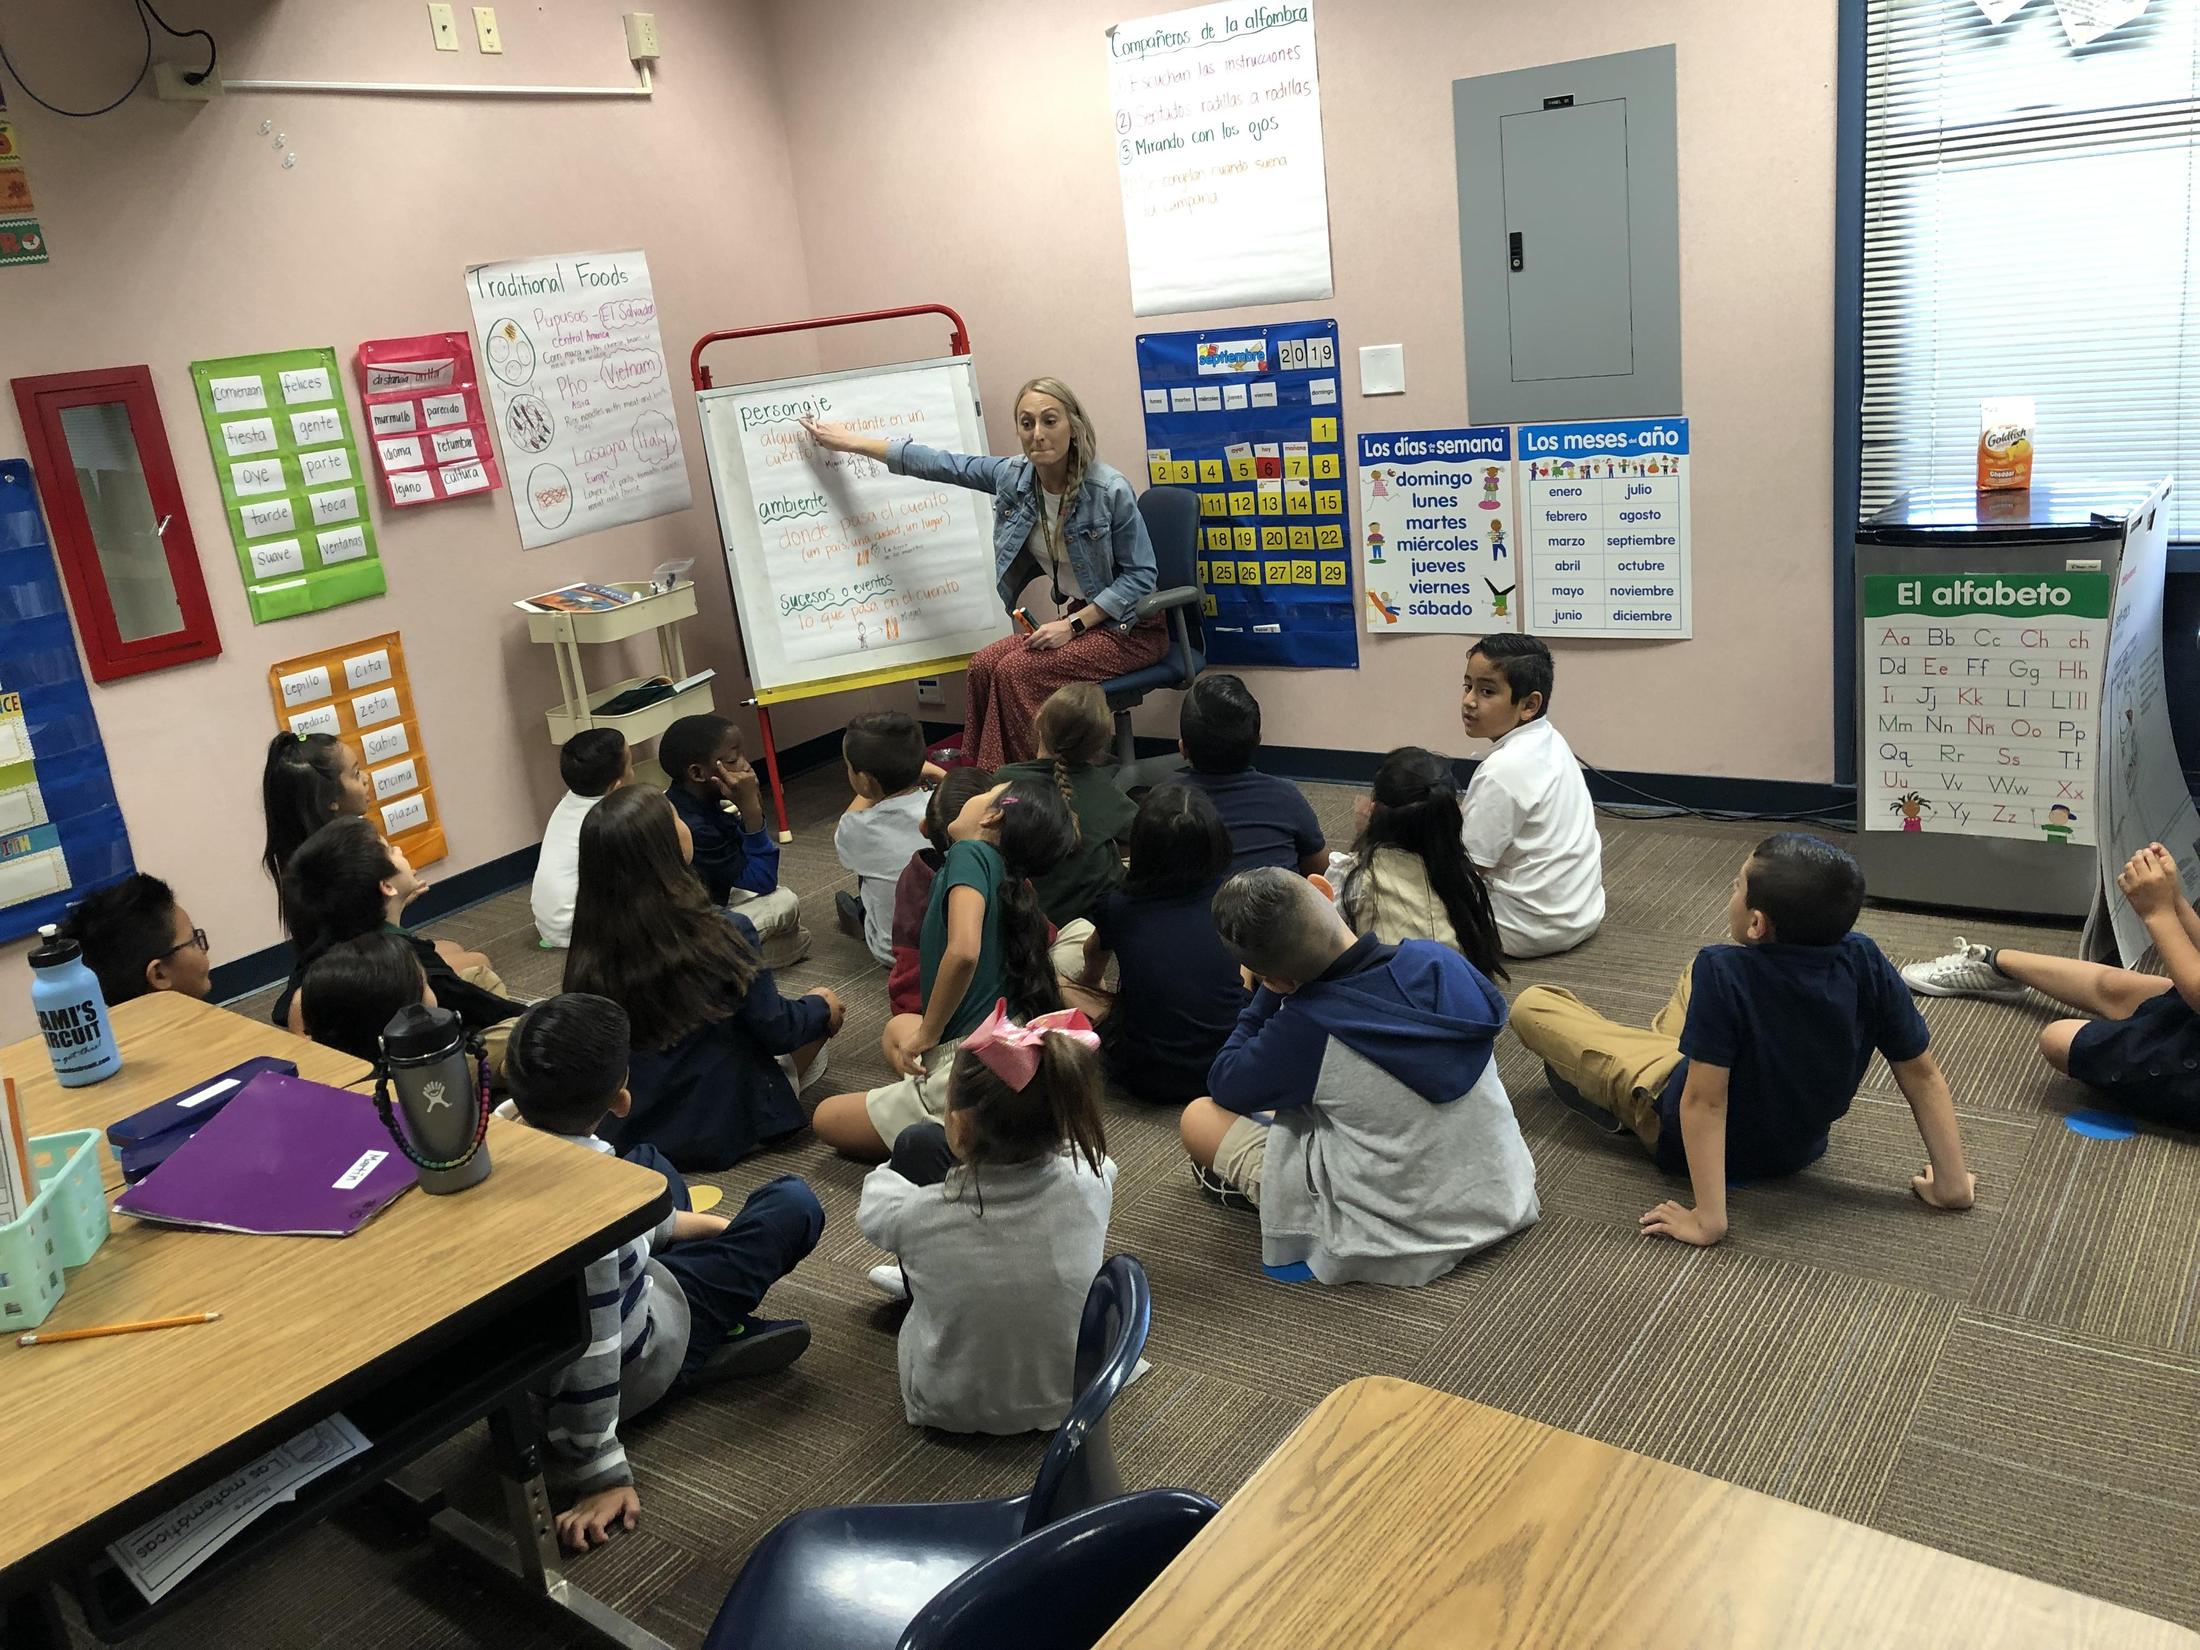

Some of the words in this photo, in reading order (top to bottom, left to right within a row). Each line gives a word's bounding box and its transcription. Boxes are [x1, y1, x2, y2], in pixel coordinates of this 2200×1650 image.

[1111, 30, 1191, 61] Compañeros
[1201, 23, 1215, 40] de
[1225, 16, 1238, 33] la
[1245, 7, 1308, 29] alfombra
[1198, 62, 1215, 77] las
[1224, 45, 1301, 72] instrucciones
[1250, 92, 1260, 104] a
[1265, 79, 1312, 102] rodillas
[1135, 135, 1185, 156] Mirando
[1192, 128, 1214, 144] con
[1222, 122, 1239, 139] los
[1248, 116, 1279, 142] ojos
[468, 263, 565, 299] Traditional
[576, 262, 630, 287] Foods
[533, 307, 589, 337] Pupusas
[600, 305, 614, 322] El
[1199, 348, 1265, 368] septiembre
[284, 375, 322, 394] felices
[556, 374, 588, 400] Pho
[605, 359, 656, 384] Vietnam
[427, 404, 460, 421] parecido
[571, 399, 591, 410] Asia
[740, 395, 832, 431] personaje
[890, 413, 902, 426] en
[909, 409, 925, 422] un
[227, 426, 268, 443] fiesta
[299, 416, 334, 440] gente
[1988, 428, 2027, 447] Goldfish
[437, 437, 473, 452] retumbar
[1364, 438, 1391, 458] Los
[1394, 436, 1427, 456] días
[1436, 436, 1503, 455] semana
[1527, 431, 1559, 453] Los
[1564, 432, 1627, 450] meses
[1638, 426, 1679, 447] año
[572, 439, 628, 471] Lasagna
[636, 429, 669, 458] Italy
[765, 447, 813, 467] cuento
[306, 454, 342, 479] parte
[394, 480, 422, 495] lejano
[1396, 470, 1473, 490] domingo
[1412, 492, 1458, 508] lunes
[1549, 487, 1583, 498] enero
[1625, 483, 1653, 500] julio
[319, 499, 347, 514] toca
[759, 491, 828, 518] ambiente
[1208, 500, 1222, 512] 11
[1234, 497, 1251, 511] 12
[1262, 497, 1278, 511] 13
[1290, 496, 1308, 510] 14
[1320, 495, 1337, 510] 15
[251, 506, 289, 525] tarde
[778, 521, 829, 550] donde
[840, 510, 878, 540] pasa
[881, 501, 895, 521] el
[900, 491, 949, 516] cuento
[1406, 515, 1467, 530] martes
[1546, 510, 1588, 522] febrero
[1619, 509, 1662, 523] agosto
[322, 535, 363, 556] ventanas
[1212, 532, 1228, 546] 18
[1238, 532, 1252, 546] 19
[1266, 531, 1283, 545] 20
[1294, 531, 1309, 545] 21
[1320, 530, 1339, 544] 22
[1397, 536, 1479, 552] miércoles
[1548, 536, 1586, 547] marzo
[1607, 535, 1676, 550] septiembre
[1216, 566, 1232, 580] 25
[1241, 567, 1257, 580] 26
[1269, 566, 1286, 580] 27
[1295, 565, 1312, 579] 28
[1325, 566, 1342, 580] 29
[1411, 557, 1466, 577] jueves
[1555, 560, 1581, 572] abril
[1617, 560, 1665, 572] octubre
[841, 587, 849, 597] o
[853, 574, 893, 594] eventos
[1409, 580, 1471, 595] viernes
[1552, 586, 1585, 599] mayo
[1610, 585, 1675, 597] noviembre
[1897, 581, 1922, 606] El
[1932, 580, 2071, 607] alfabeto
[799, 614, 814, 630] lo
[820, 608, 845, 630] que
[851, 603, 879, 622] pasa
[884, 597, 899, 610] en
[914, 578, 960, 600] cuento
[1409, 600, 1473, 616] sábado
[1552, 610, 1583, 624] junio
[1613, 610, 1673, 622] diciembre
[1881, 628, 1910, 646] Aa
[1928, 628, 1955, 647] Bb
[1973, 628, 2001, 647] Cc
[2020, 629, 2049, 649] Ch
[2068, 630, 2089, 650] ch
[1880, 657, 1907, 675] Dd
[1923, 657, 1948, 676] Ee
[1967, 658, 1990, 677] Ff
[2009, 659, 2040, 686] Gg
[2059, 660, 2088, 680] Hh
[360, 697, 388, 718] zeta
[1879, 714, 1913, 733] Mm
[1926, 715, 1953, 734] Nn
[1967, 715, 1995, 736] Ññ
[2010, 718, 2042, 738] Oo
[2058, 720, 2086, 747] Pp
[1879, 743, 1913, 768] Qq
[1940, 744, 1965, 763] Rr
[1998, 747, 2021, 766] Ss
[2058, 750, 2082, 770] Tt
[1883, 771, 1908, 789] Uu
[1940, 773, 1963, 791] Vv
[1988, 775, 2029, 796] Ww
[2056, 780, 2084, 800] Xx
[388, 803, 420, 828] plaza
[1948, 802, 1970, 827] Yy
[1992, 804, 2017, 824] Zz
[38, 1000, 97, 1031] AMI'S
[44, 1020, 101, 1049] IRCUIT
[249, 1457, 284, 1479] Las
[136, 1478, 247, 1560] matemáticas
